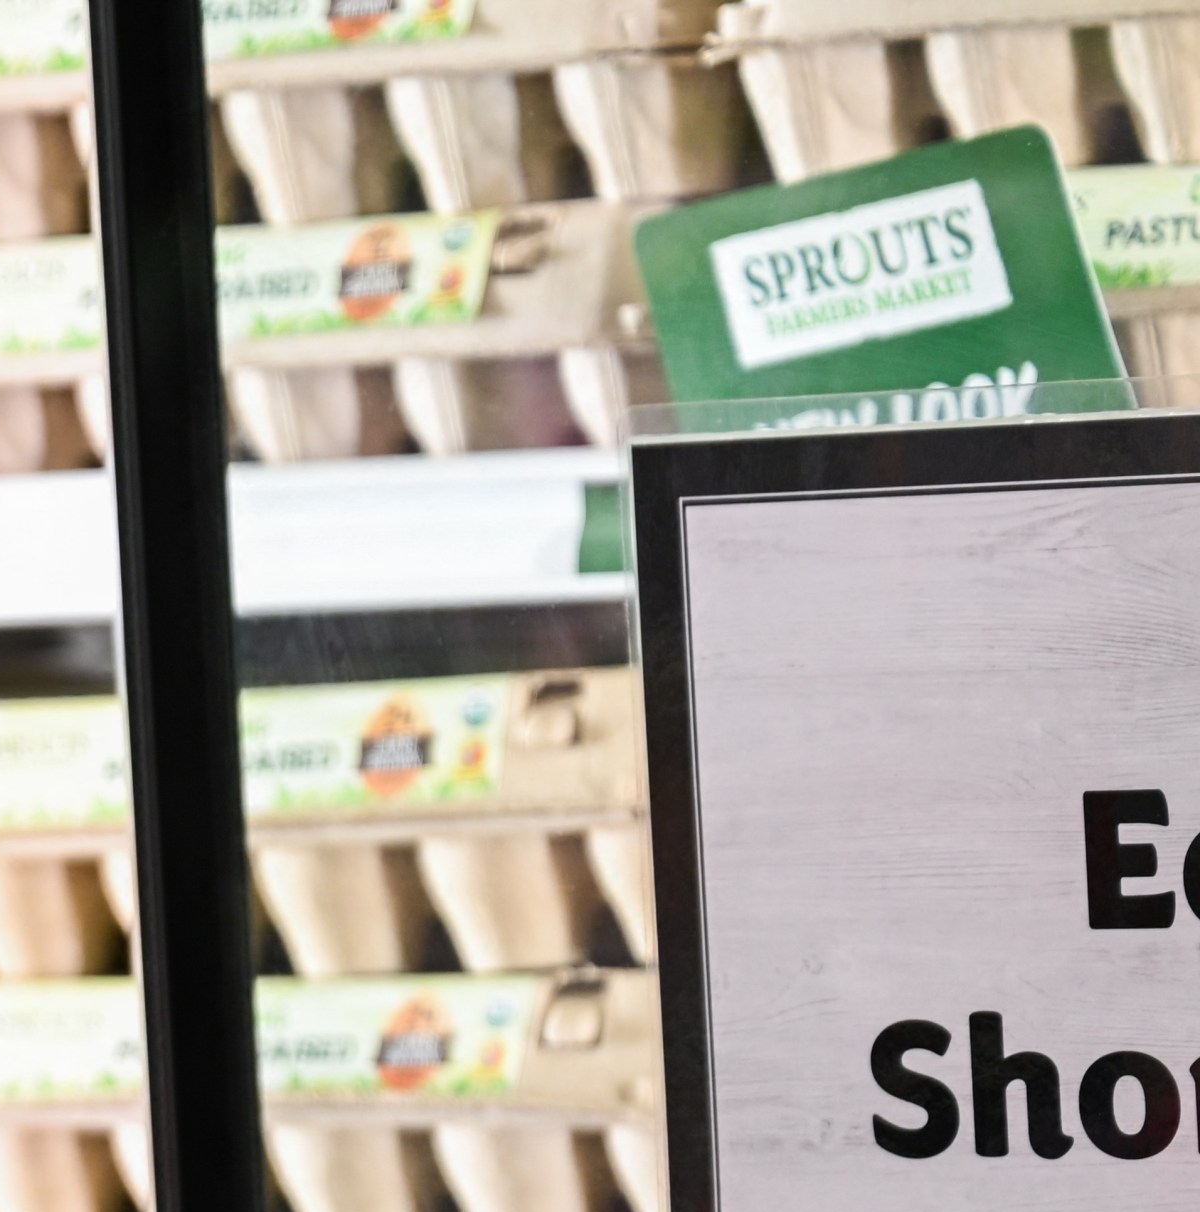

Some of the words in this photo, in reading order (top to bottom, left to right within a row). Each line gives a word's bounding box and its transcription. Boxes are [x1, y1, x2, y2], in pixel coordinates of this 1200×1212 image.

[743, 208, 974, 307] SPROUTS
[766, 297, 869, 336] FARMERS
[874, 267, 972, 312] MARKET
[1083, 789, 1200, 930] E
[870, 1010, 1200, 1160] Sho
